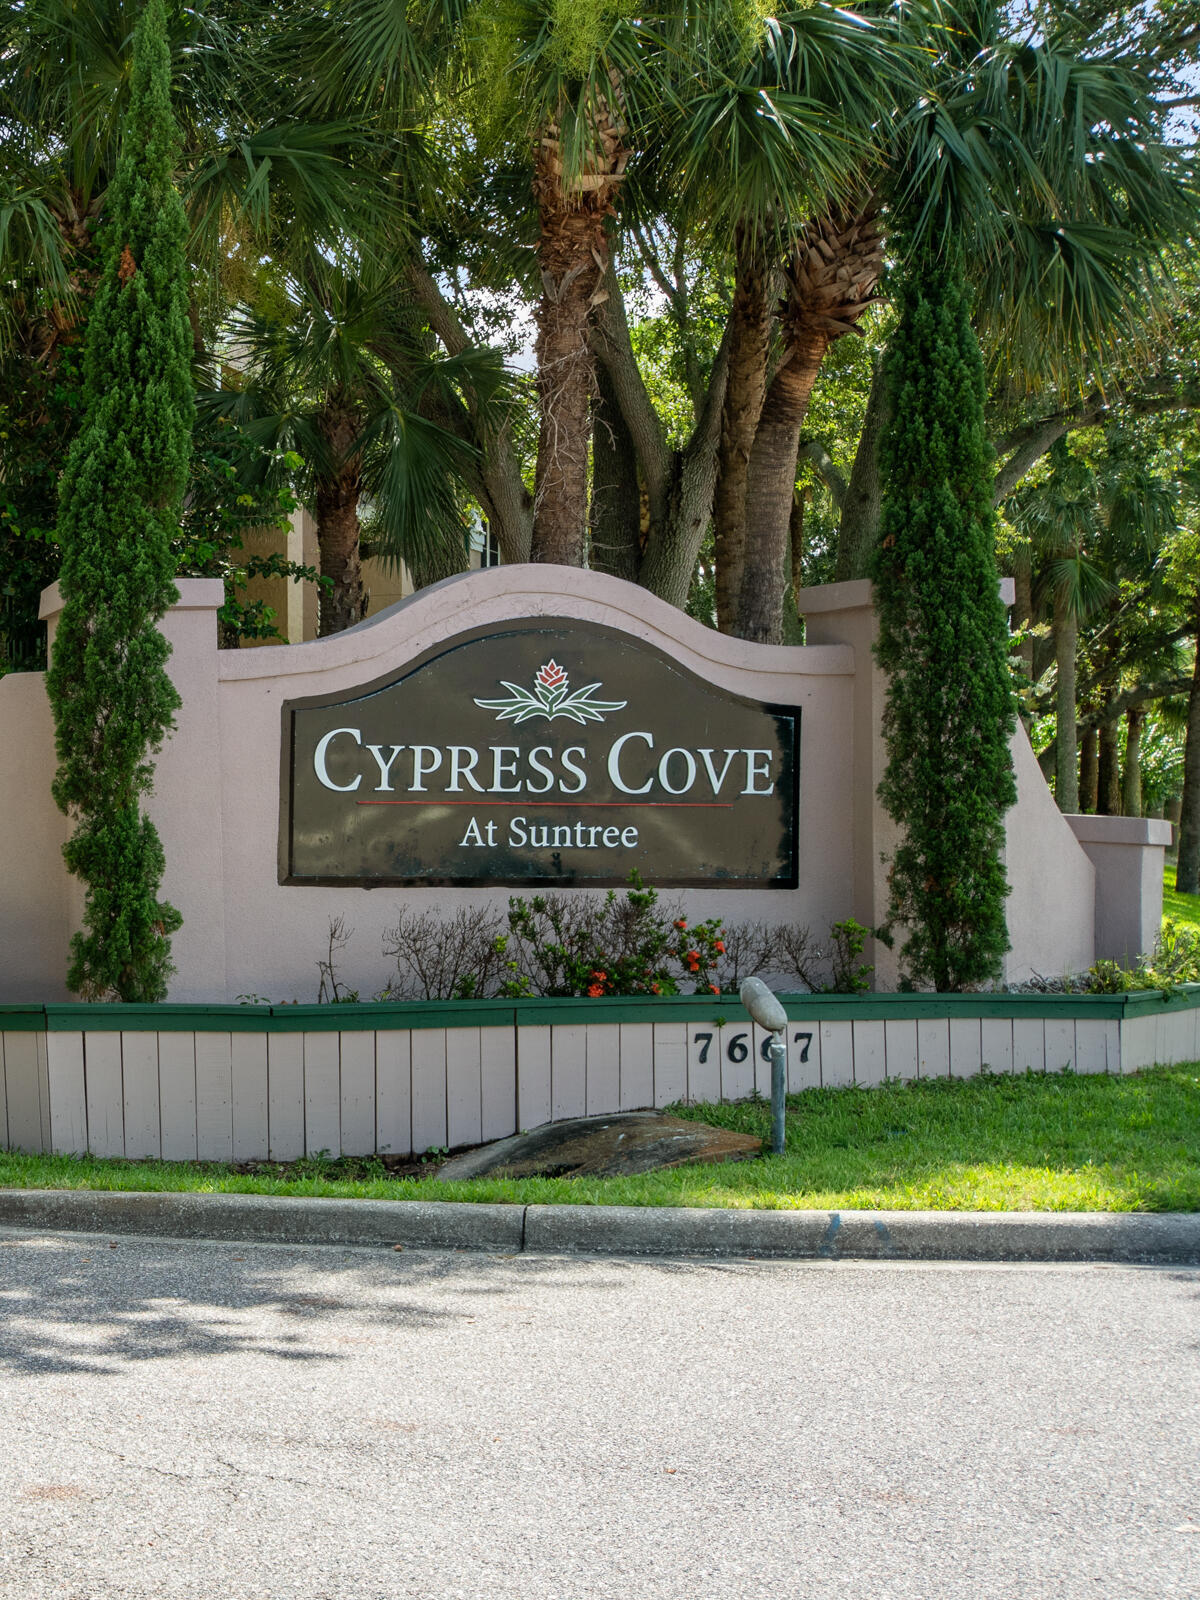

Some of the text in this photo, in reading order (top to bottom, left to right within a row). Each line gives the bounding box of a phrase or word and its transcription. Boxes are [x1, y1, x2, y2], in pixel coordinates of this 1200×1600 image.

[313, 727, 776, 797] CYPRESS COVE
[459, 816, 640, 849] At Suntree
